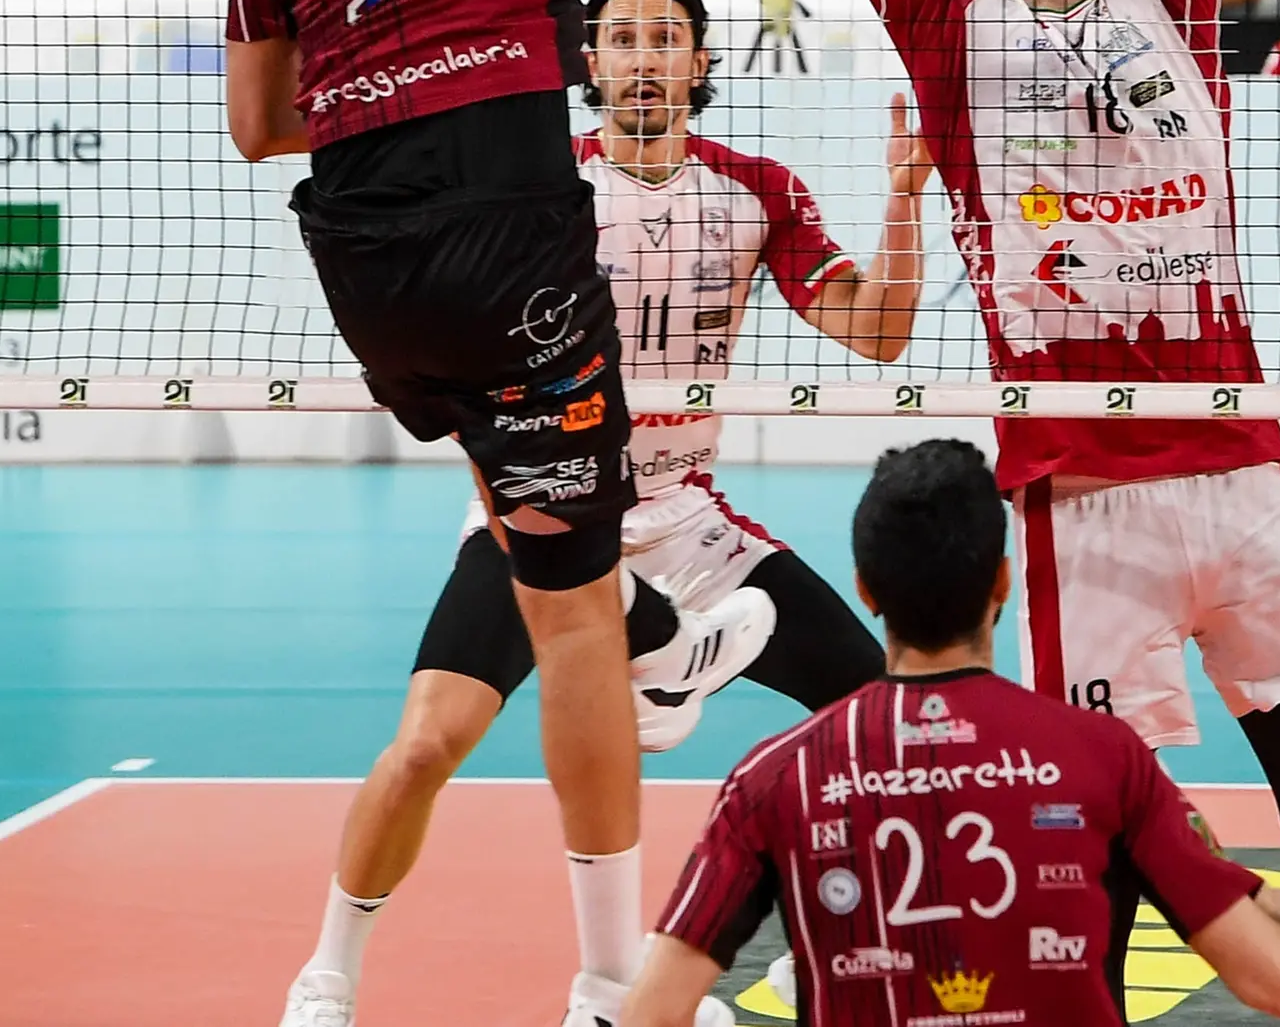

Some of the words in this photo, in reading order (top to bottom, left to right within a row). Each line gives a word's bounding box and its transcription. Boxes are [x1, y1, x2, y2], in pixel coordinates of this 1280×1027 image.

[1086, 72, 1133, 134] 18
[1066, 174, 1207, 224] CONAD
[640, 294, 669, 351] 11
[821, 748, 1061, 805] #lazzaretto
[875, 813, 1017, 926] 23
